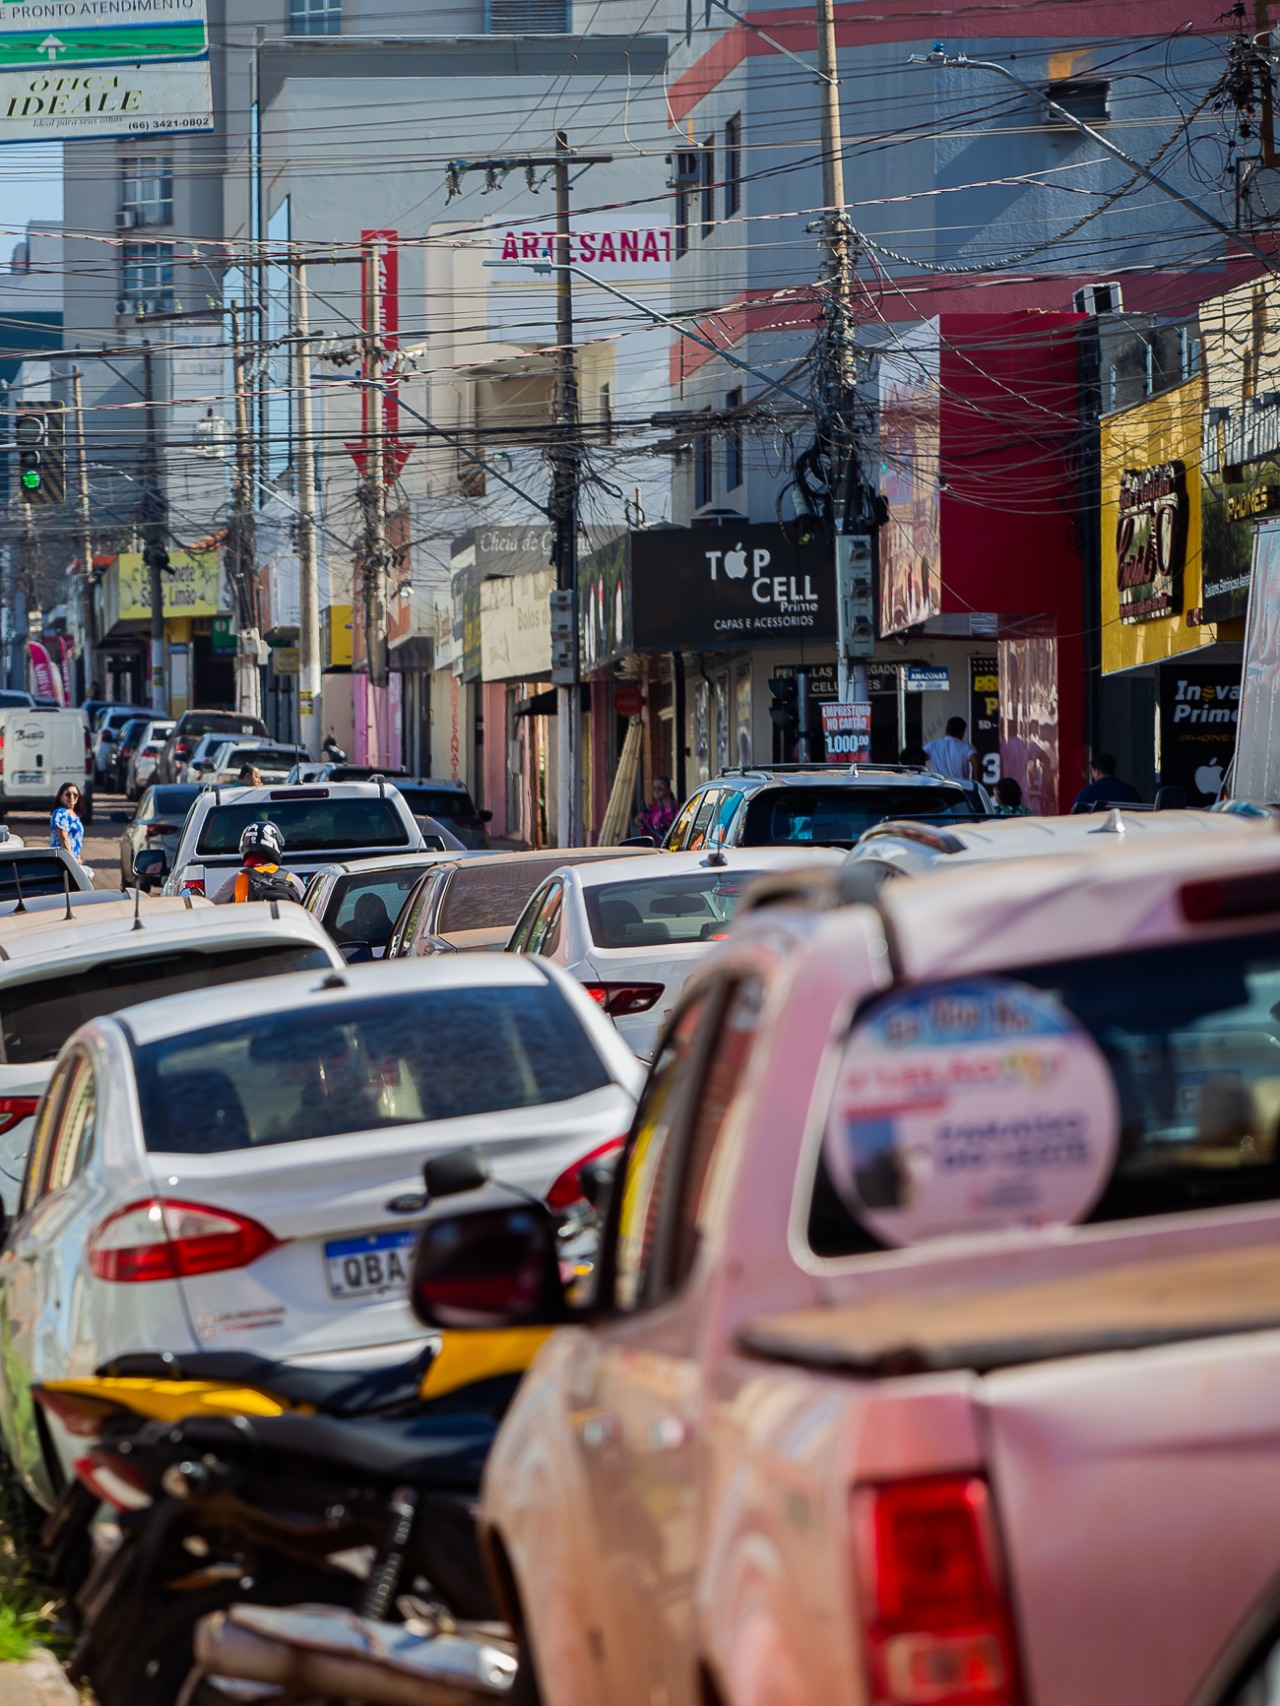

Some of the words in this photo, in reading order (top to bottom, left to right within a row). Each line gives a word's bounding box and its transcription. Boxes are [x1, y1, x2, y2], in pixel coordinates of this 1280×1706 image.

[12, 3, 76, 19] PRONTO
[80, 0, 195, 14] ATENDIMENTO
[29, 75, 121, 92] ÓTICA
[7, 90, 143, 117] IDEALE
[33, 118, 54, 128] Ideal
[56, 118, 77, 128] para
[128, 119, 150, 130] (66)
[153, 117, 210, 129] 3421-0802
[501, 231, 670, 262] ARTSANAT
[480, 531, 518, 552] Cheia
[521, 531, 538, 551] de
[751, 575, 818, 603] CELL
[780, 601, 818, 612] Prime
[517, 606, 540, 631] Bolos
[714, 618, 744, 630] CAPAS
[746, 618, 752, 628] E
[754, 614, 814, 628] ACESSÓRIOS
[826, 718, 839, 729] NO
[342, 1252, 416, 1289] QBA
